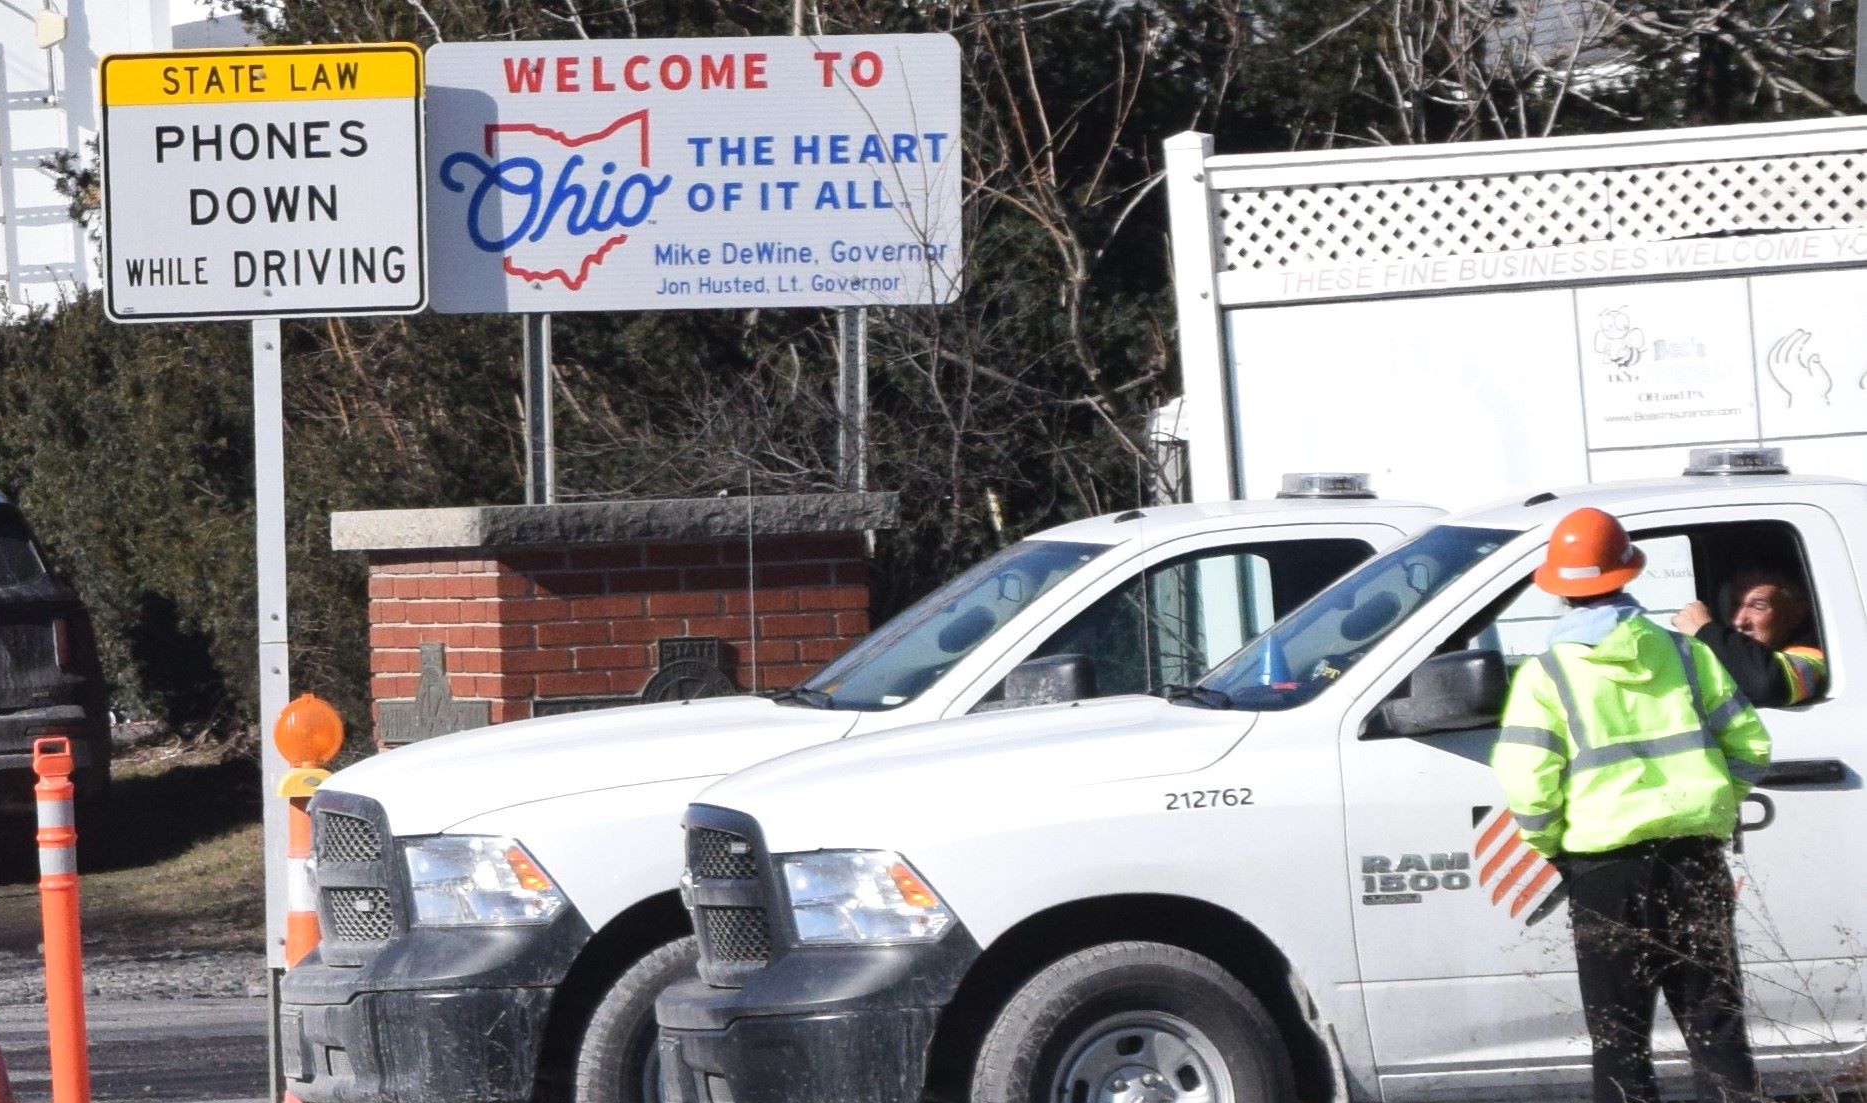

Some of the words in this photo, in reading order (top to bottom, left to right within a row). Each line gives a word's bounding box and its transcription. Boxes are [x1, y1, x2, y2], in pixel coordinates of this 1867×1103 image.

[162, 64, 265, 95] STATE
[290, 62, 359, 92] LAW
[503, 53, 769, 94] WELCOME
[814, 51, 884, 88] TO
[155, 120, 369, 163] PHONES
[687, 136, 775, 167] THE
[793, 132, 949, 165] HEART
[190, 184, 338, 225] DOWN
[439, 152, 673, 252] Ohio
[687, 182, 743, 213] OF
[760, 181, 800, 211] IT
[815, 179, 894, 210] ALL
[126, 257, 209, 287] WHILE
[234, 246, 406, 287] DRIVING
[654, 243, 711, 266] Mike
[831, 240, 949, 263] Governor
[1279, 266, 1374, 294] THESE
[1384, 260, 1449, 287] FINE
[1458, 247, 1648, 281] BUSINESSES
[1664, 236, 1821, 267] WELCOME
[656, 277, 691, 295] Jon
[778, 275, 803, 292] Lt.
[811, 274, 900, 292] Governor
[1164, 787, 1254, 811] 212762
[1361, 852, 1470, 873] RAM
[1362, 872, 1471, 893] 1500
